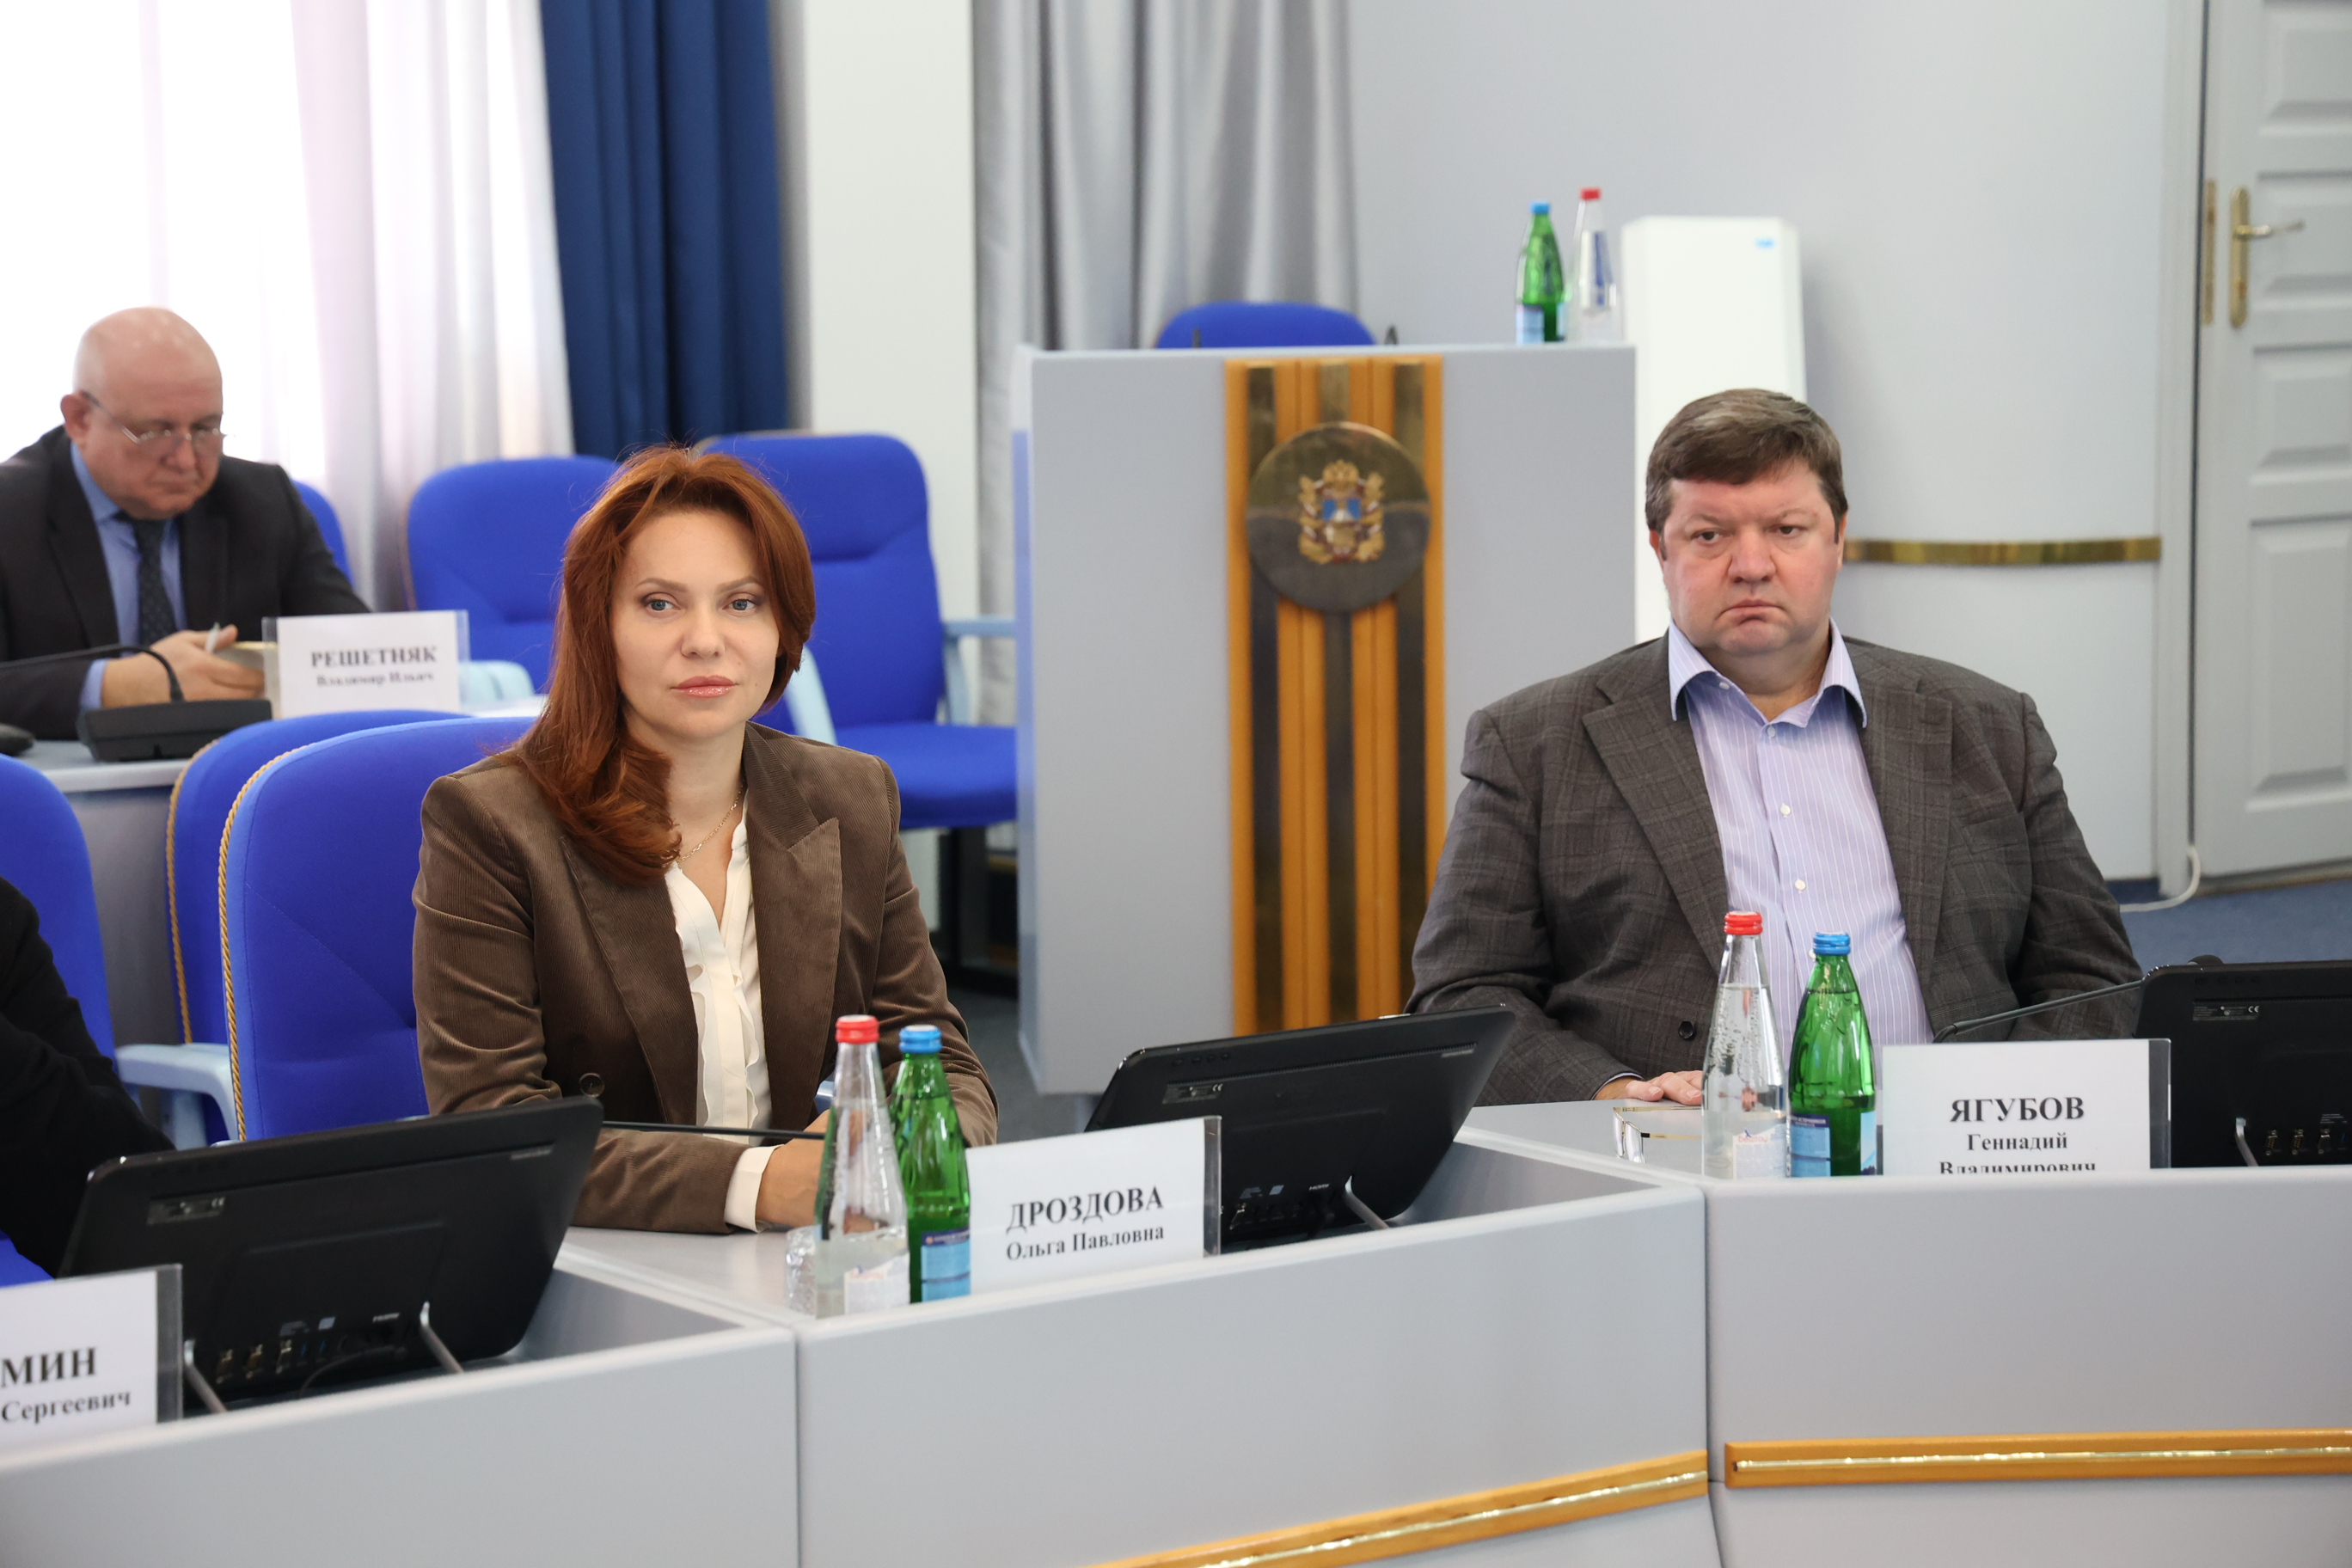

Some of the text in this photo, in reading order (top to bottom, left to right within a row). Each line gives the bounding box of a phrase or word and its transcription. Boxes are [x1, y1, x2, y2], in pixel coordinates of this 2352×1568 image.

[310, 647, 437, 668] РЕШЕТНЯК
[1950, 1096, 2085, 1123] ЯГУБОВ
[1968, 1132, 2068, 1151] Геннадий
[1006, 1185, 1164, 1234] ДРОЗДОВА
[1006, 1227, 1164, 1260] Ольга Павловна
[1, 1347, 96, 1387] МИН
[1, 1392, 131, 1424] Сергеевич
